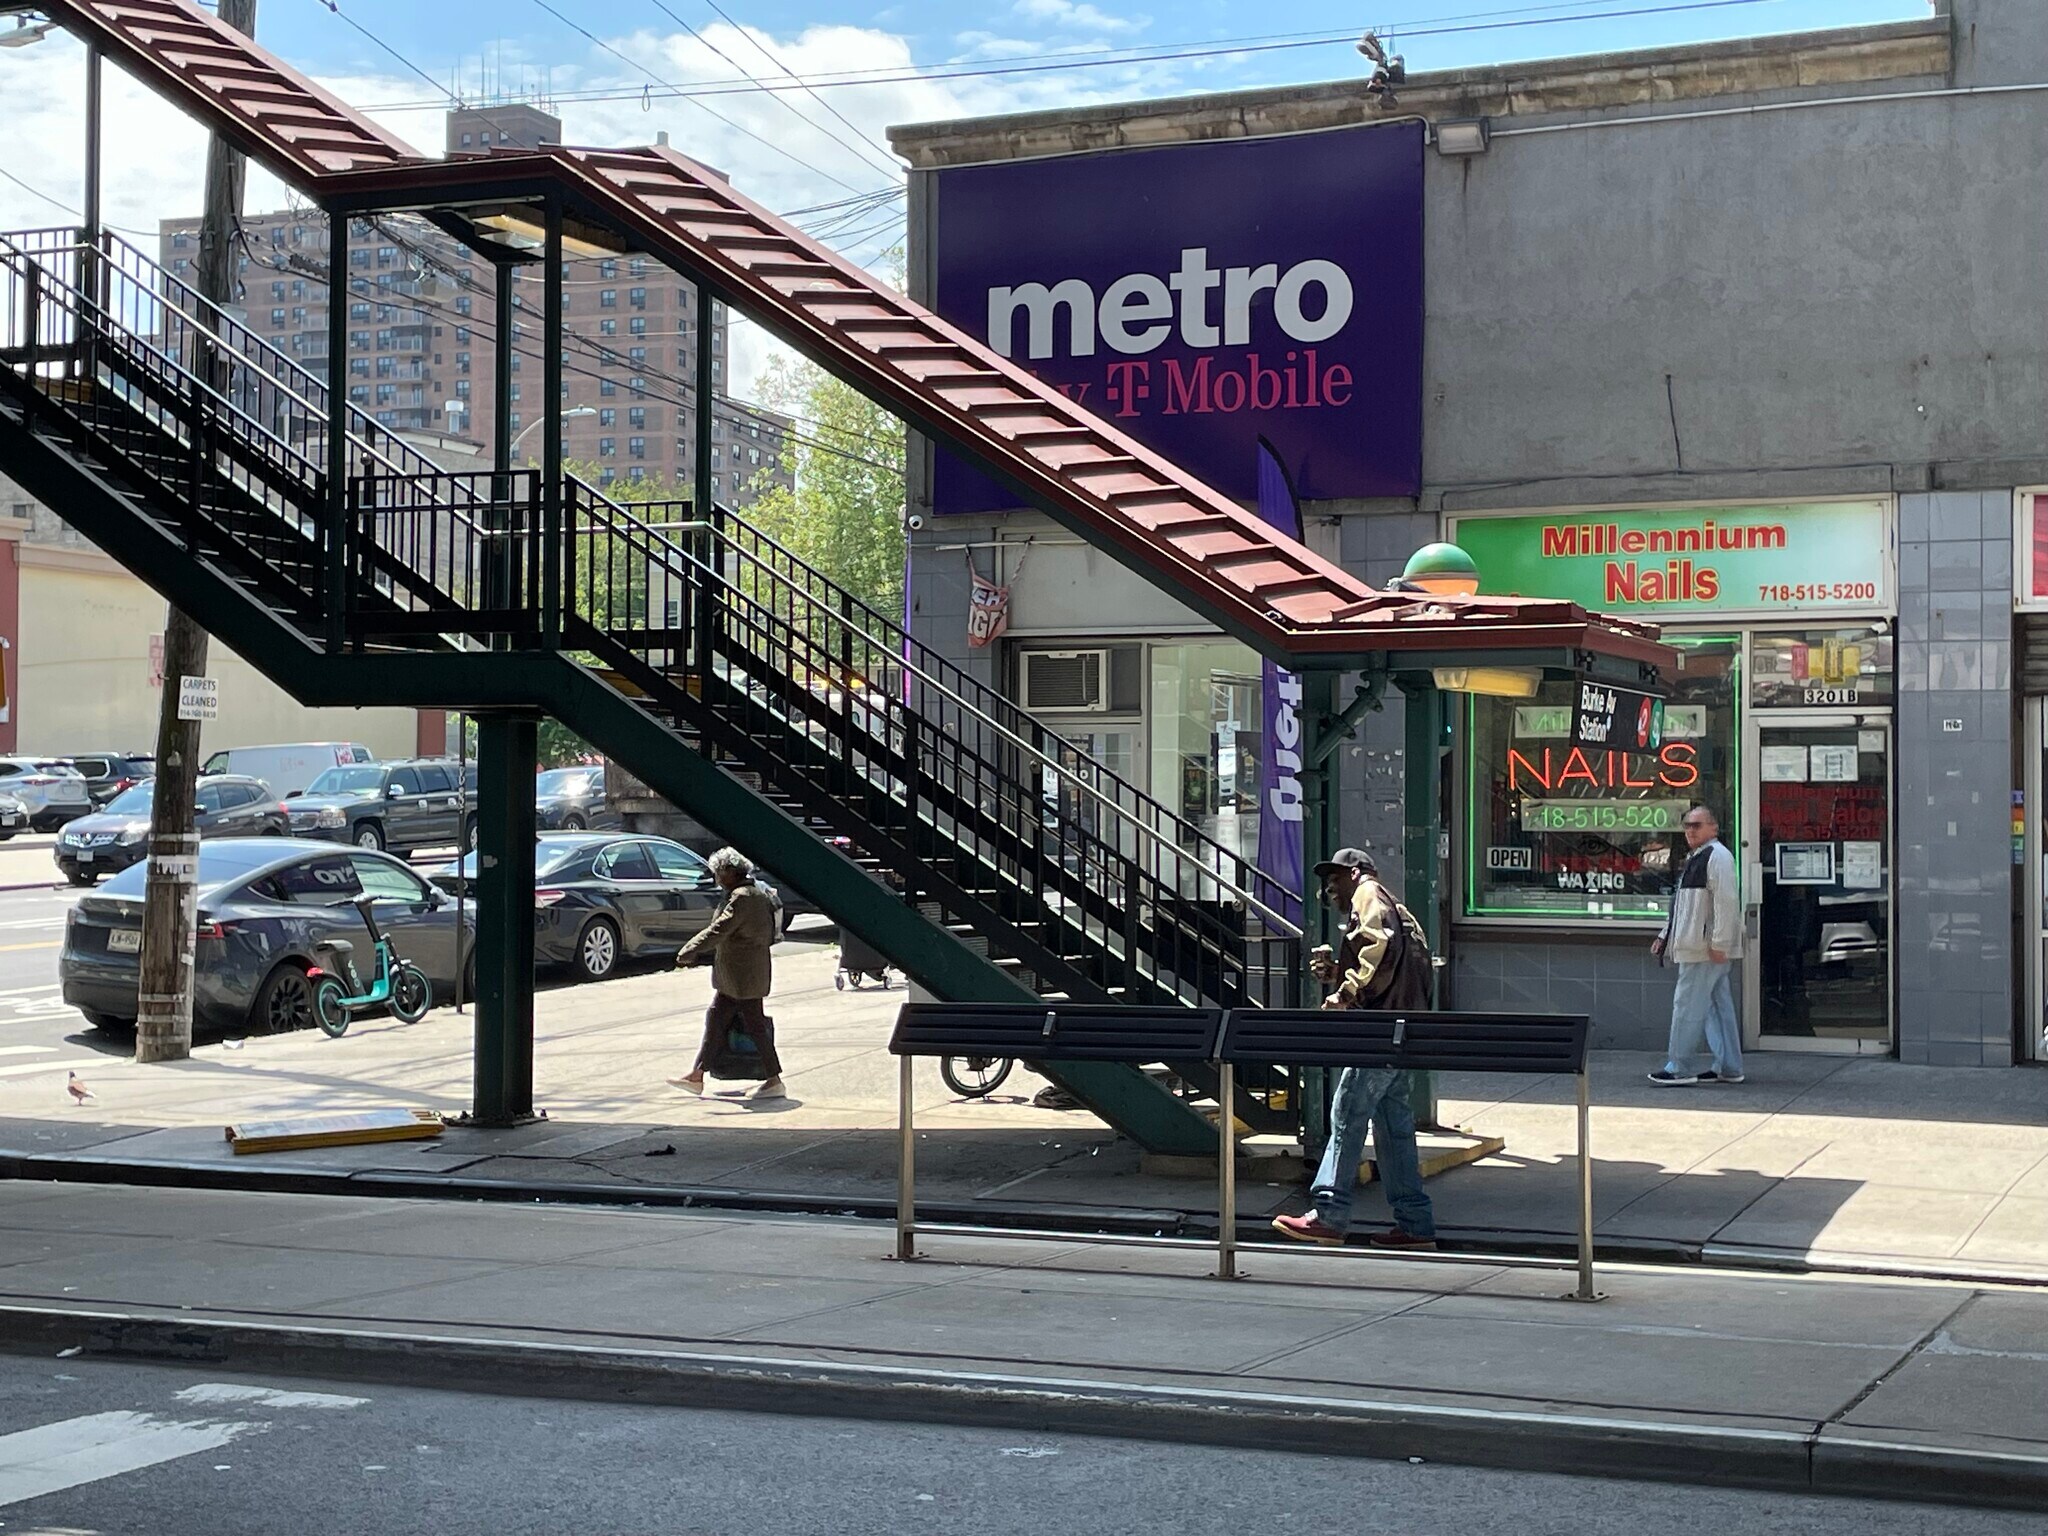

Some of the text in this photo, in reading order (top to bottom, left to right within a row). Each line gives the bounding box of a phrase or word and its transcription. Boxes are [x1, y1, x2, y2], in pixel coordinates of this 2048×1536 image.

[988, 247, 1354, 359] metro
[1161, 349, 1353, 415] Mobile
[1542, 521, 1787, 557] Millennium
[1604, 559, 1720, 604] Nails
[1758, 583, 1876, 602] 718-515-5200
[183, 678, 216, 691] CARPETS
[1805, 689, 1856, 703] 3201B
[181, 694, 217, 707] CLEANED
[1581, 685, 1618, 715] Burke Av
[1579, 714, 1607, 742] Station
[1508, 742, 1699, 790] NAILS
[1490, 849, 1529, 868] OPEN
[1557, 872, 1625, 889] WAXING
